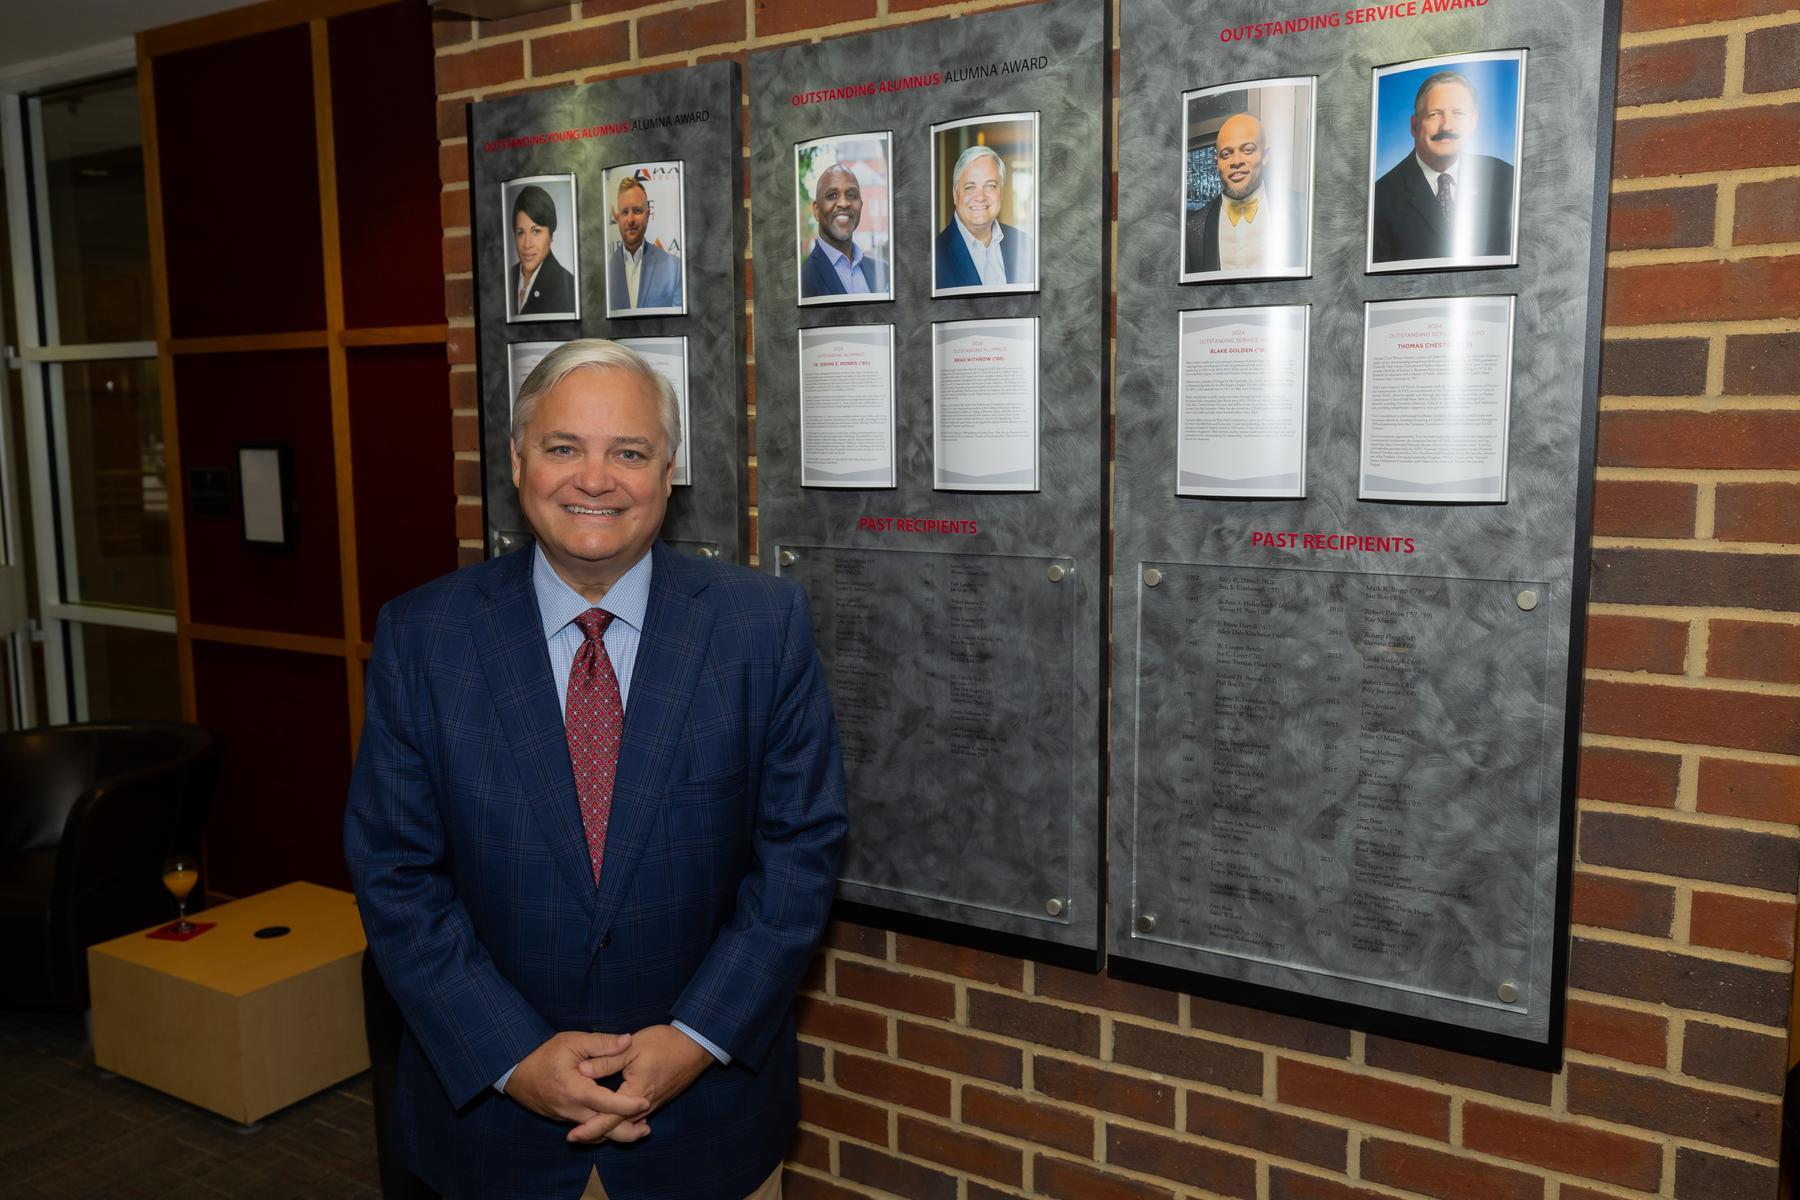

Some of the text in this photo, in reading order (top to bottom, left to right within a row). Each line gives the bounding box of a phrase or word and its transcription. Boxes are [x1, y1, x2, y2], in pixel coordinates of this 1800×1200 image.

[1219, 12, 1340, 43] OUTSTANDING
[1346, 1, 1417, 26] SERVICE
[791, 55, 1048, 108] OUTSTANDING ALUMNUS ALUMNA AWARD
[484, 110, 709, 153] OUTSTANDING YOUNG ALUMNUS ALUMNA AWARD
[1397, 342, 1424, 350] THOMAS
[859, 516, 978, 535] PAST RECIPIENTS
[1251, 531, 1416, 554] PAST RECIPIENTS
[1328, 605, 1344, 613] 2010
